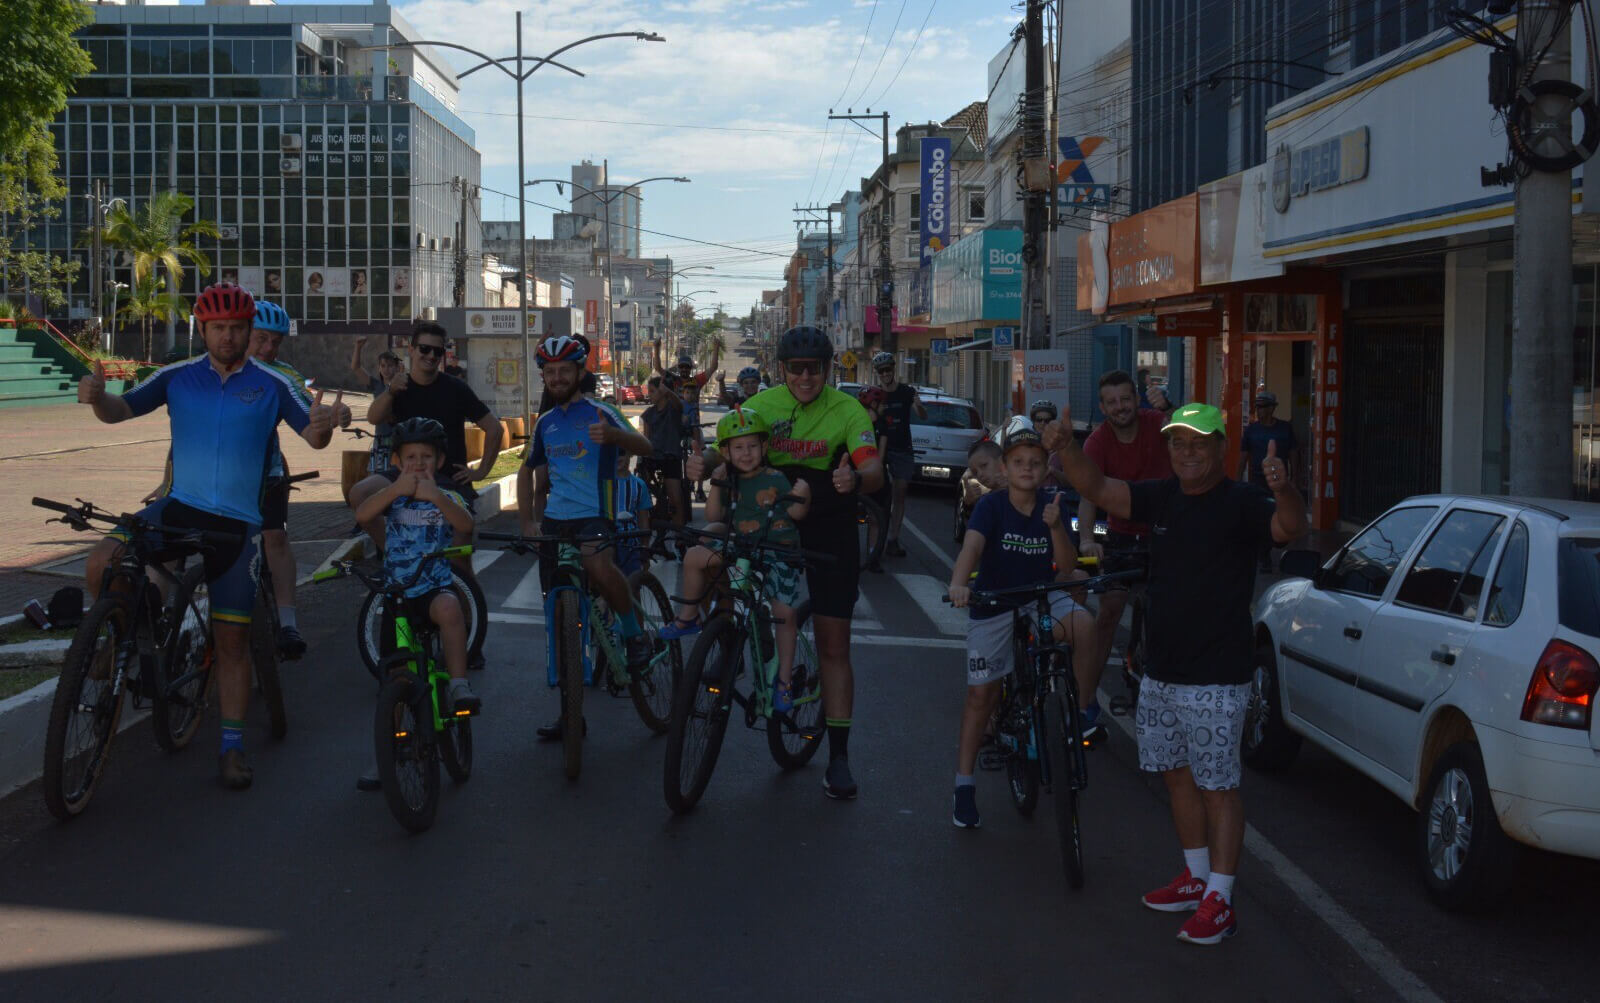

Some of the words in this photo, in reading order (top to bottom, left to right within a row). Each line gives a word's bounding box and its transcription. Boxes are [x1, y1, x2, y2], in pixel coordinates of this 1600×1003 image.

[310, 134, 345, 145] JUSTIÇA
[348, 134, 384, 144] FEDERAL
[351, 155, 364, 163] 301
[373, 155, 385, 163] 302
[928, 147, 945, 234] Colombo
[1045, 186, 1106, 204] AIXA
[1136, 252, 1175, 287] ECONOMIA
[491, 314, 516, 322] BRIGADA
[492, 321, 516, 329] MILITAR
[1029, 363, 1065, 373] OFERTAS
[1324, 323, 1339, 498] FARMÁCIA
[1215, 689, 1224, 714] BOSS
[1216, 750, 1225, 775] BOSS
[1177, 884, 1204, 895] FILA
